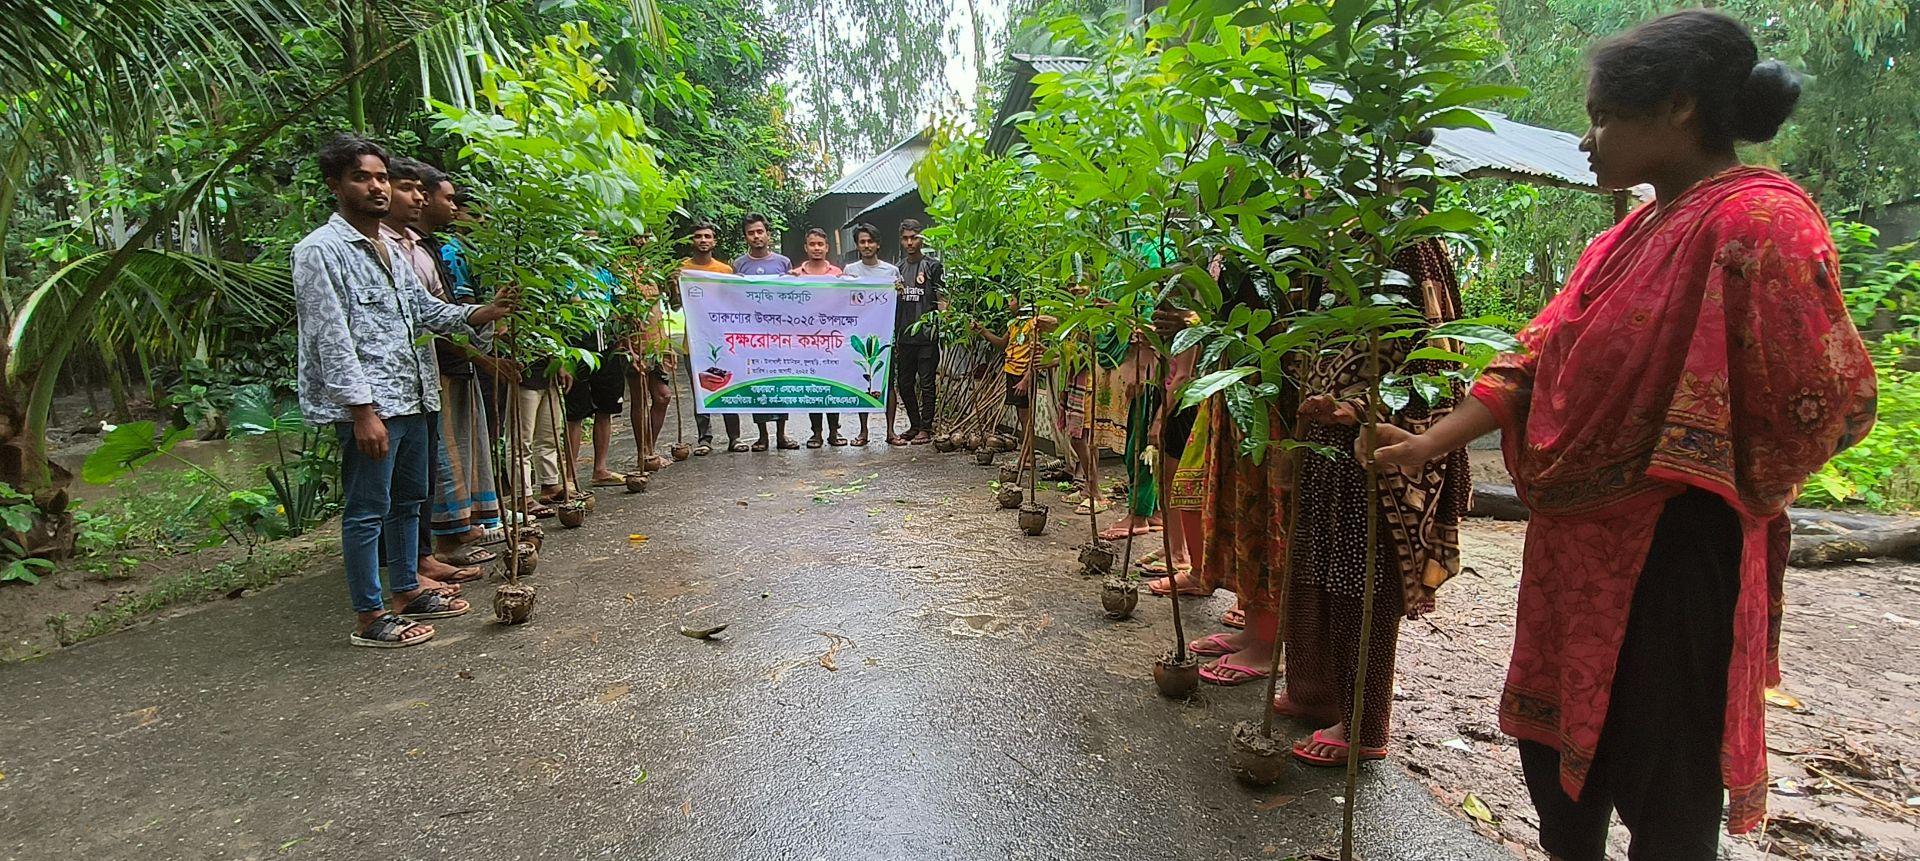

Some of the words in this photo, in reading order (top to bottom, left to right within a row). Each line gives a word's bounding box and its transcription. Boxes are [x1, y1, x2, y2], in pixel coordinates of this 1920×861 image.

[745, 289, 774, 304] সমৃদ্ধি
[777, 290, 812, 305] কর্মসূচি
[866, 292, 889, 305] SKS
[708, 311, 751, 325] তারুণ্যের
[754, 312, 815, 327] উৎসব-২০২৫
[818, 313, 858, 328] উপলক্ষ্যে
[724, 331, 792, 354] বৃক্ষরোপন
[797, 329, 845, 354] কর্মসূচি
